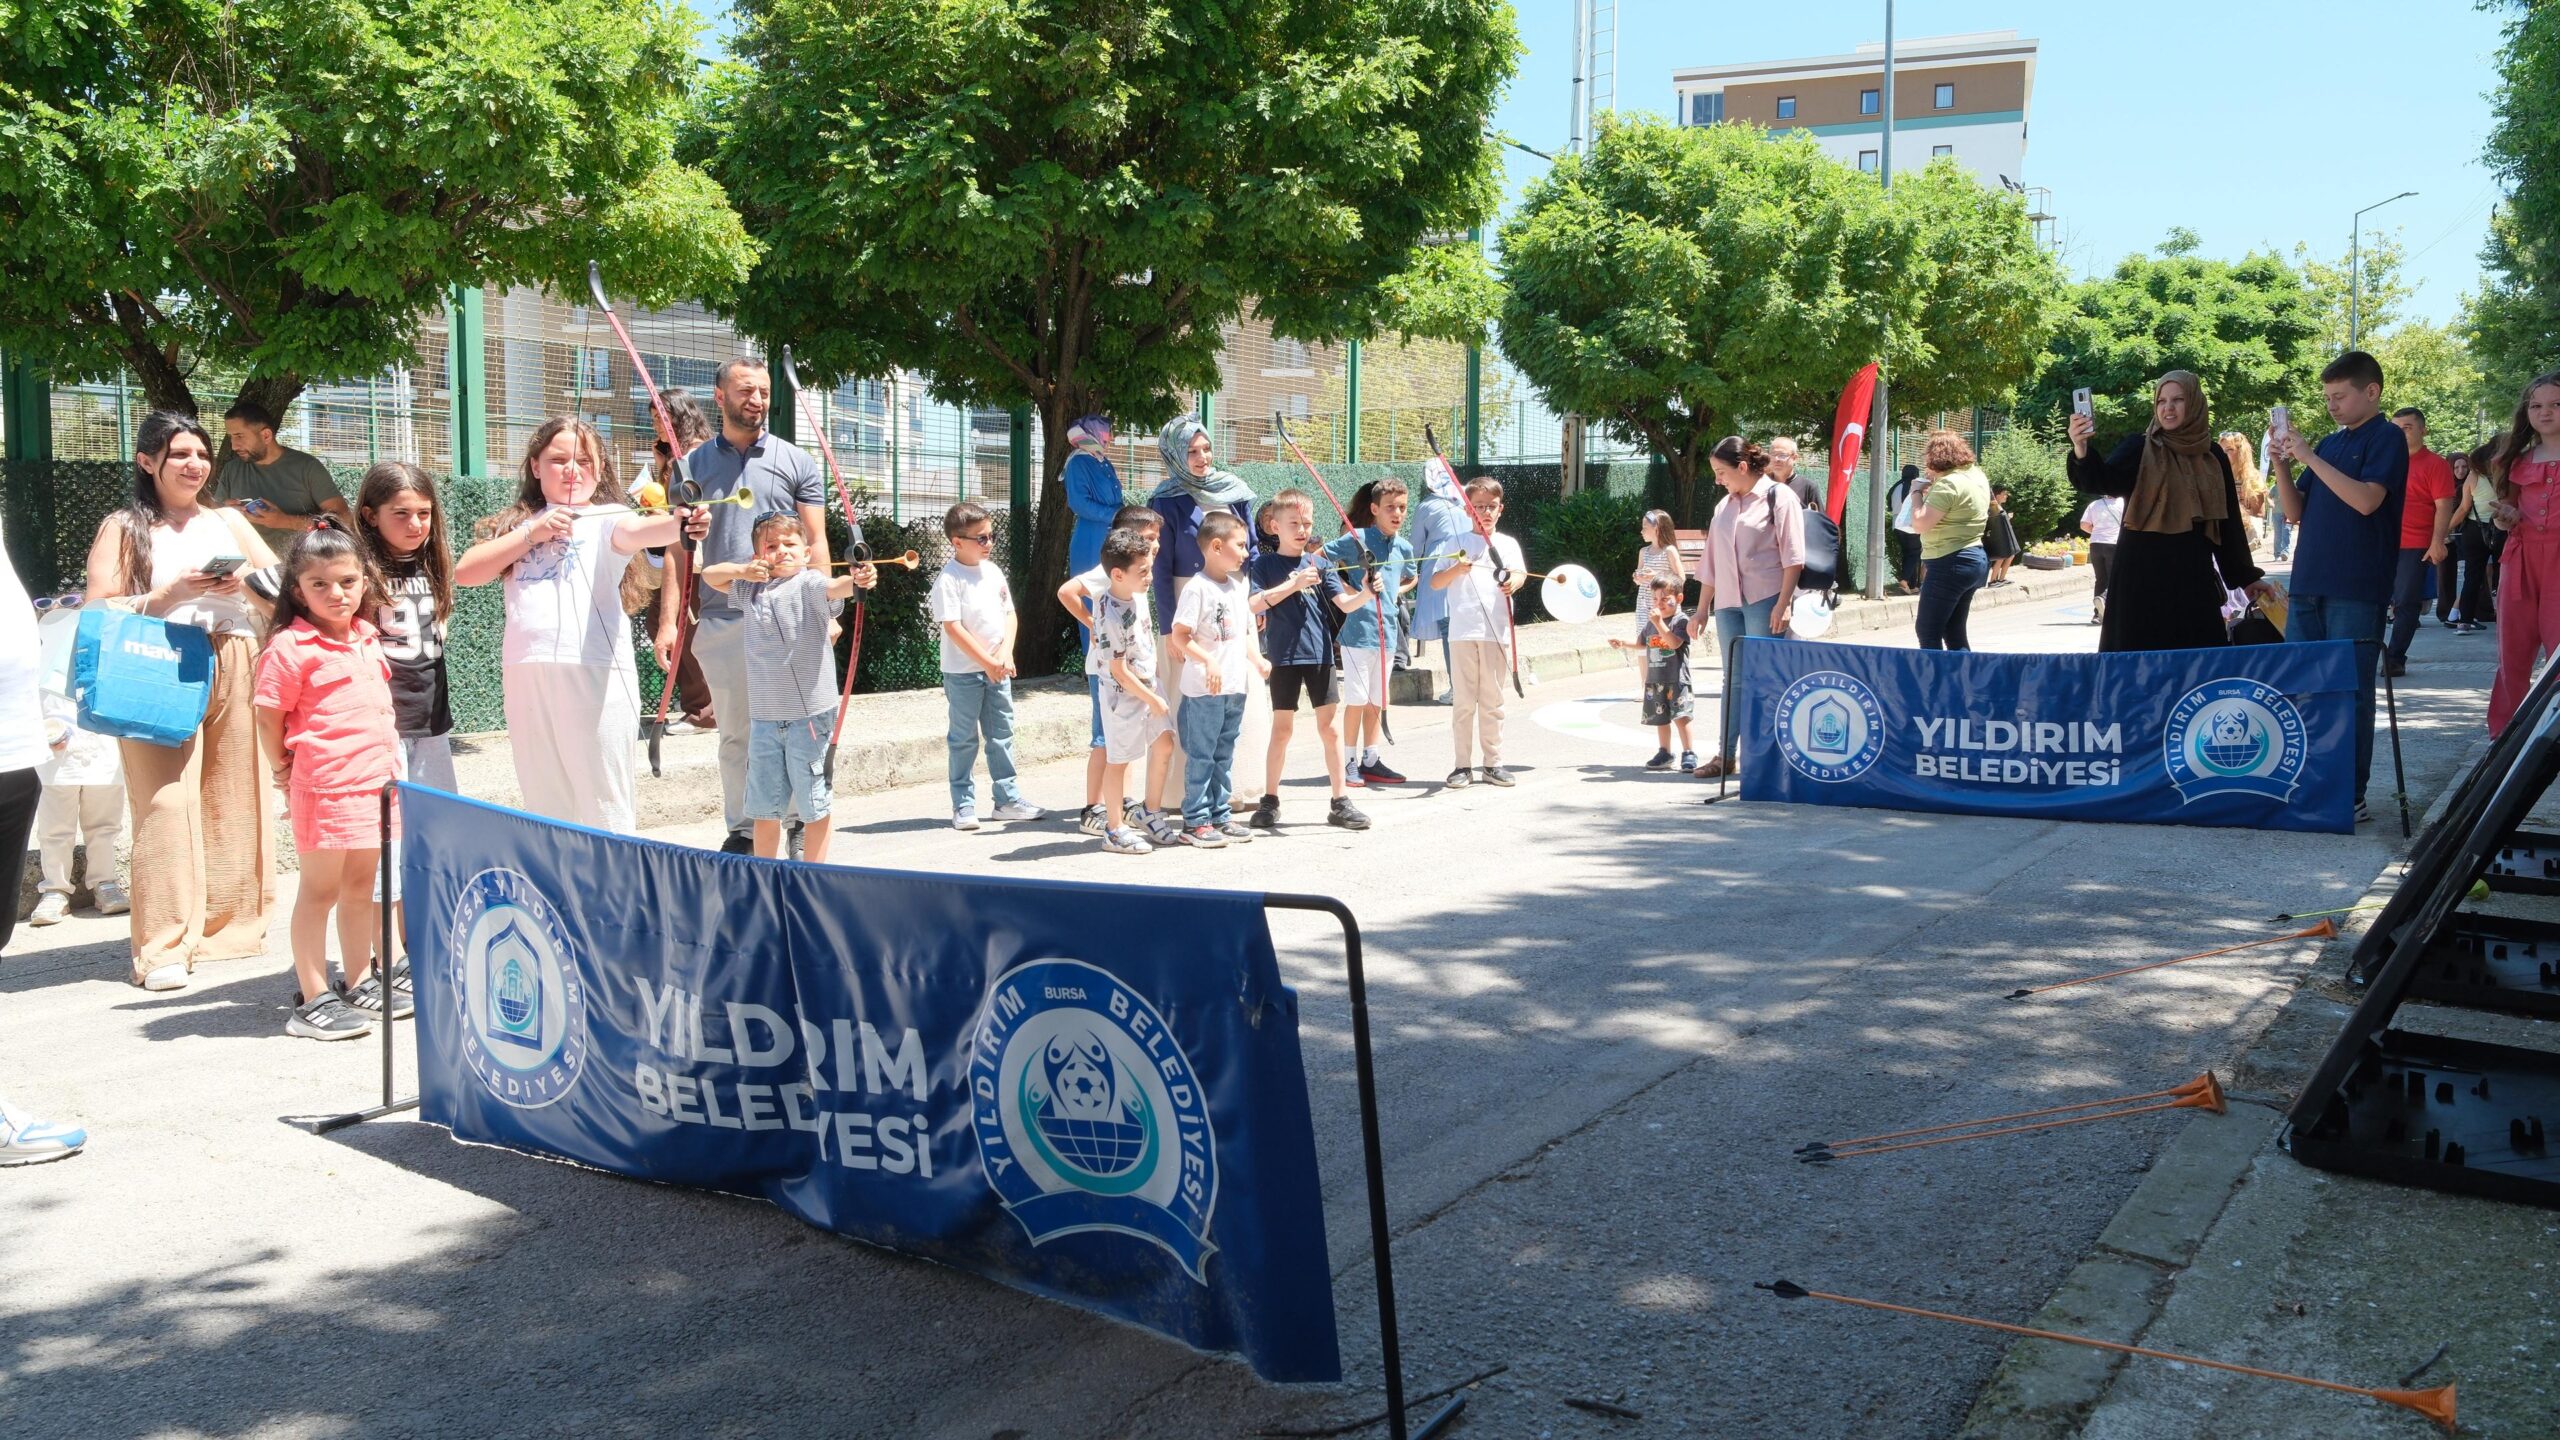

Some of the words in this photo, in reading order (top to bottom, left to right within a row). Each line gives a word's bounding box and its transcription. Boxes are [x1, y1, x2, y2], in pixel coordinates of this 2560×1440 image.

[124, 640, 182, 663] mavi
[1780, 682, 1810, 729] BURSA
[1819, 676, 1879, 731] YILDIRIM
[1913, 716, 2122, 754] YILDIRIM
[2169, 691, 2207, 773] YILDIRIM
[456, 890, 483, 982] BURSA
[495, 879, 578, 1004] YILDIRIM
[1044, 986, 1087, 1001] BURSA
[633, 975, 928, 1102] YILDRIM
[976, 985, 1027, 1177] YILDIRIM
